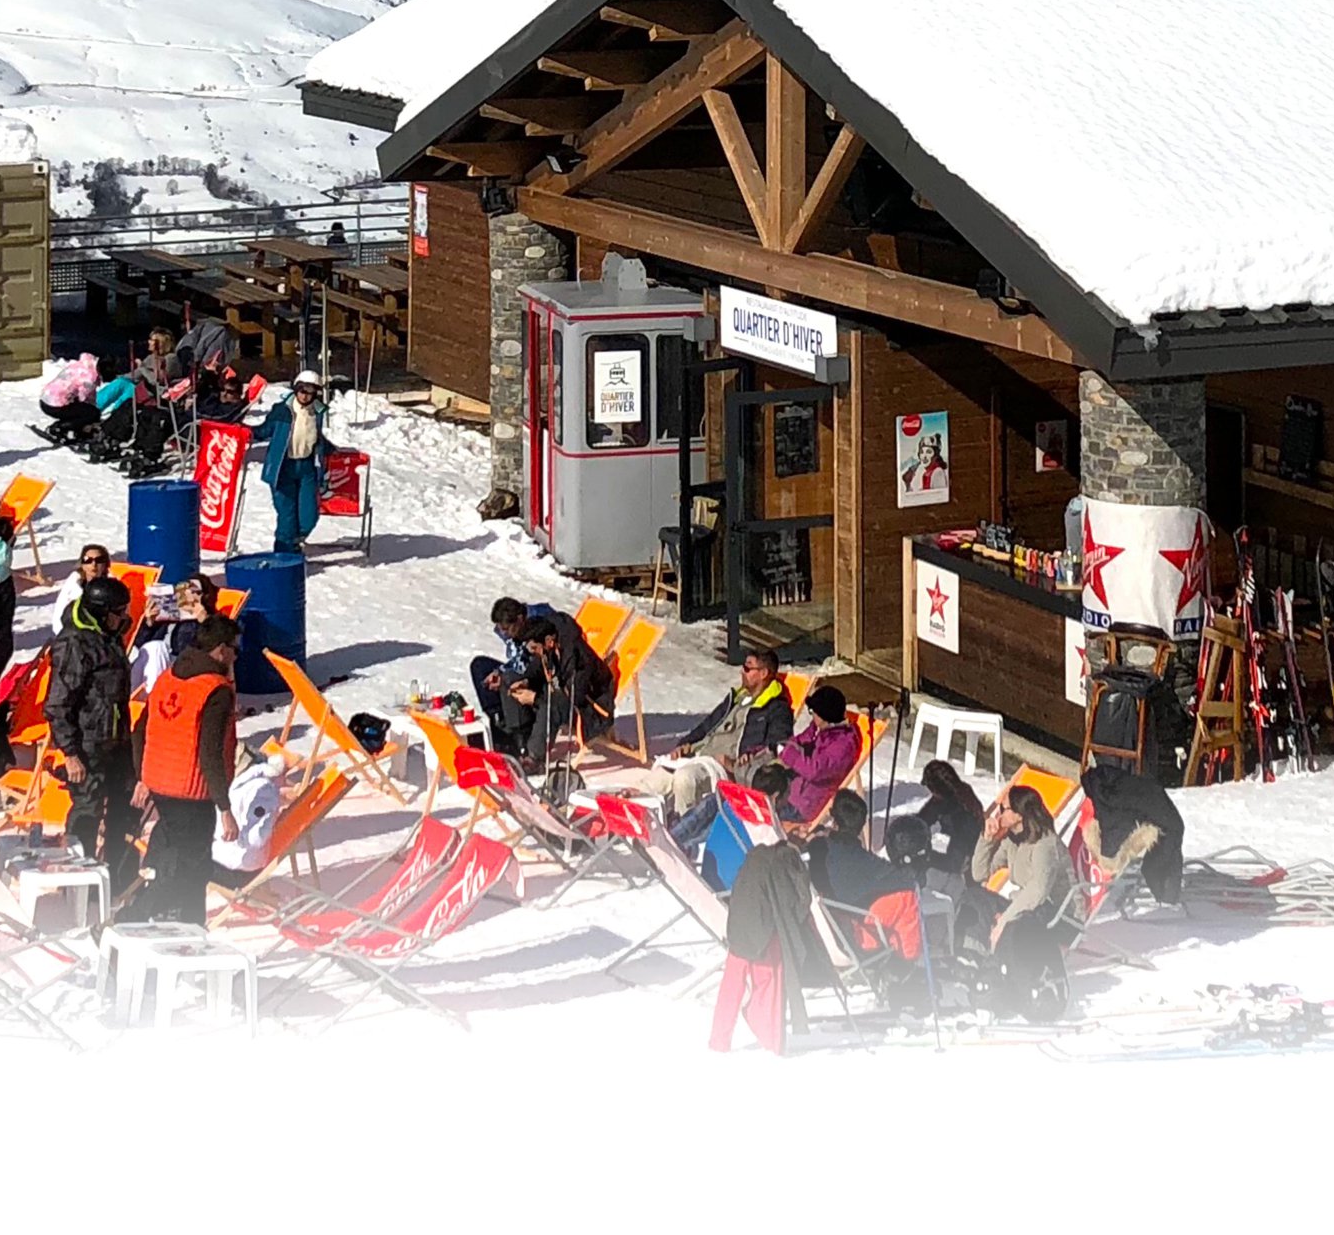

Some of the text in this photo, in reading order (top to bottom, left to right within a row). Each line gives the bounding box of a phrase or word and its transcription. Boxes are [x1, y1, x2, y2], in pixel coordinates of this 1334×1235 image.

[733, 307, 780, 344] QUARTIER
[782, 321, 823, 356] D'HIVER
[600, 391, 634, 402] QUARTIER
[600, 401, 635, 413] D'HIVER
